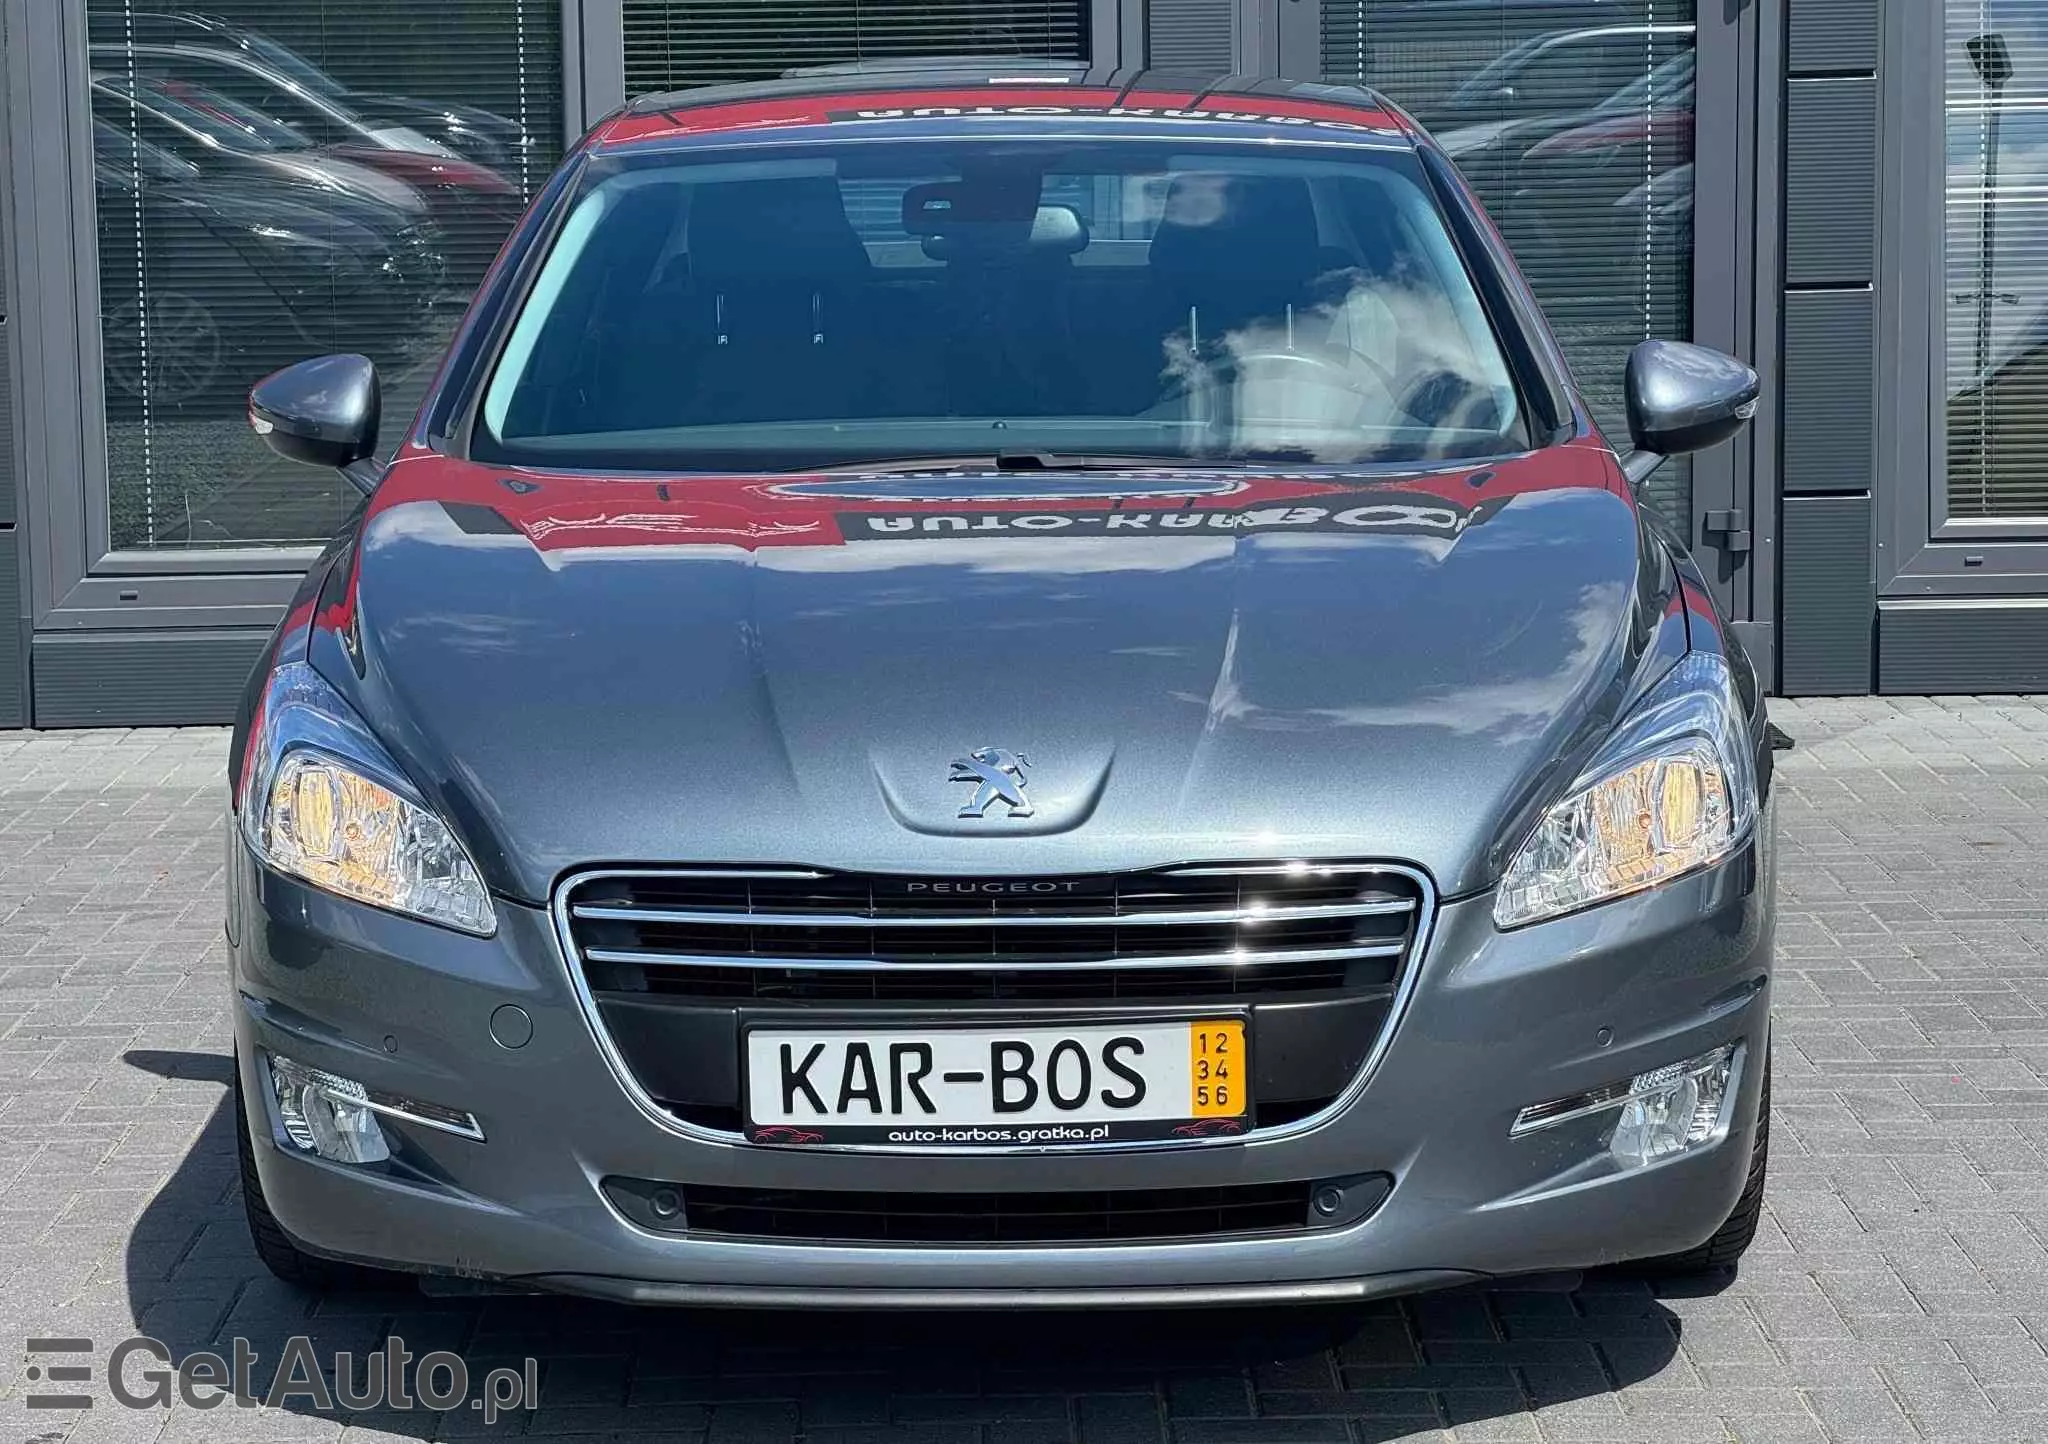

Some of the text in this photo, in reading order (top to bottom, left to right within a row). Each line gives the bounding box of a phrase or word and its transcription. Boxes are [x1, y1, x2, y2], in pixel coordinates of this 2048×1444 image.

[907, 882, 1080, 893] PEUGEOT
[779, 1037, 1147, 1115] KAR-BOS
[888, 1124, 1109, 1142] auto-karbos.gratka.pl
